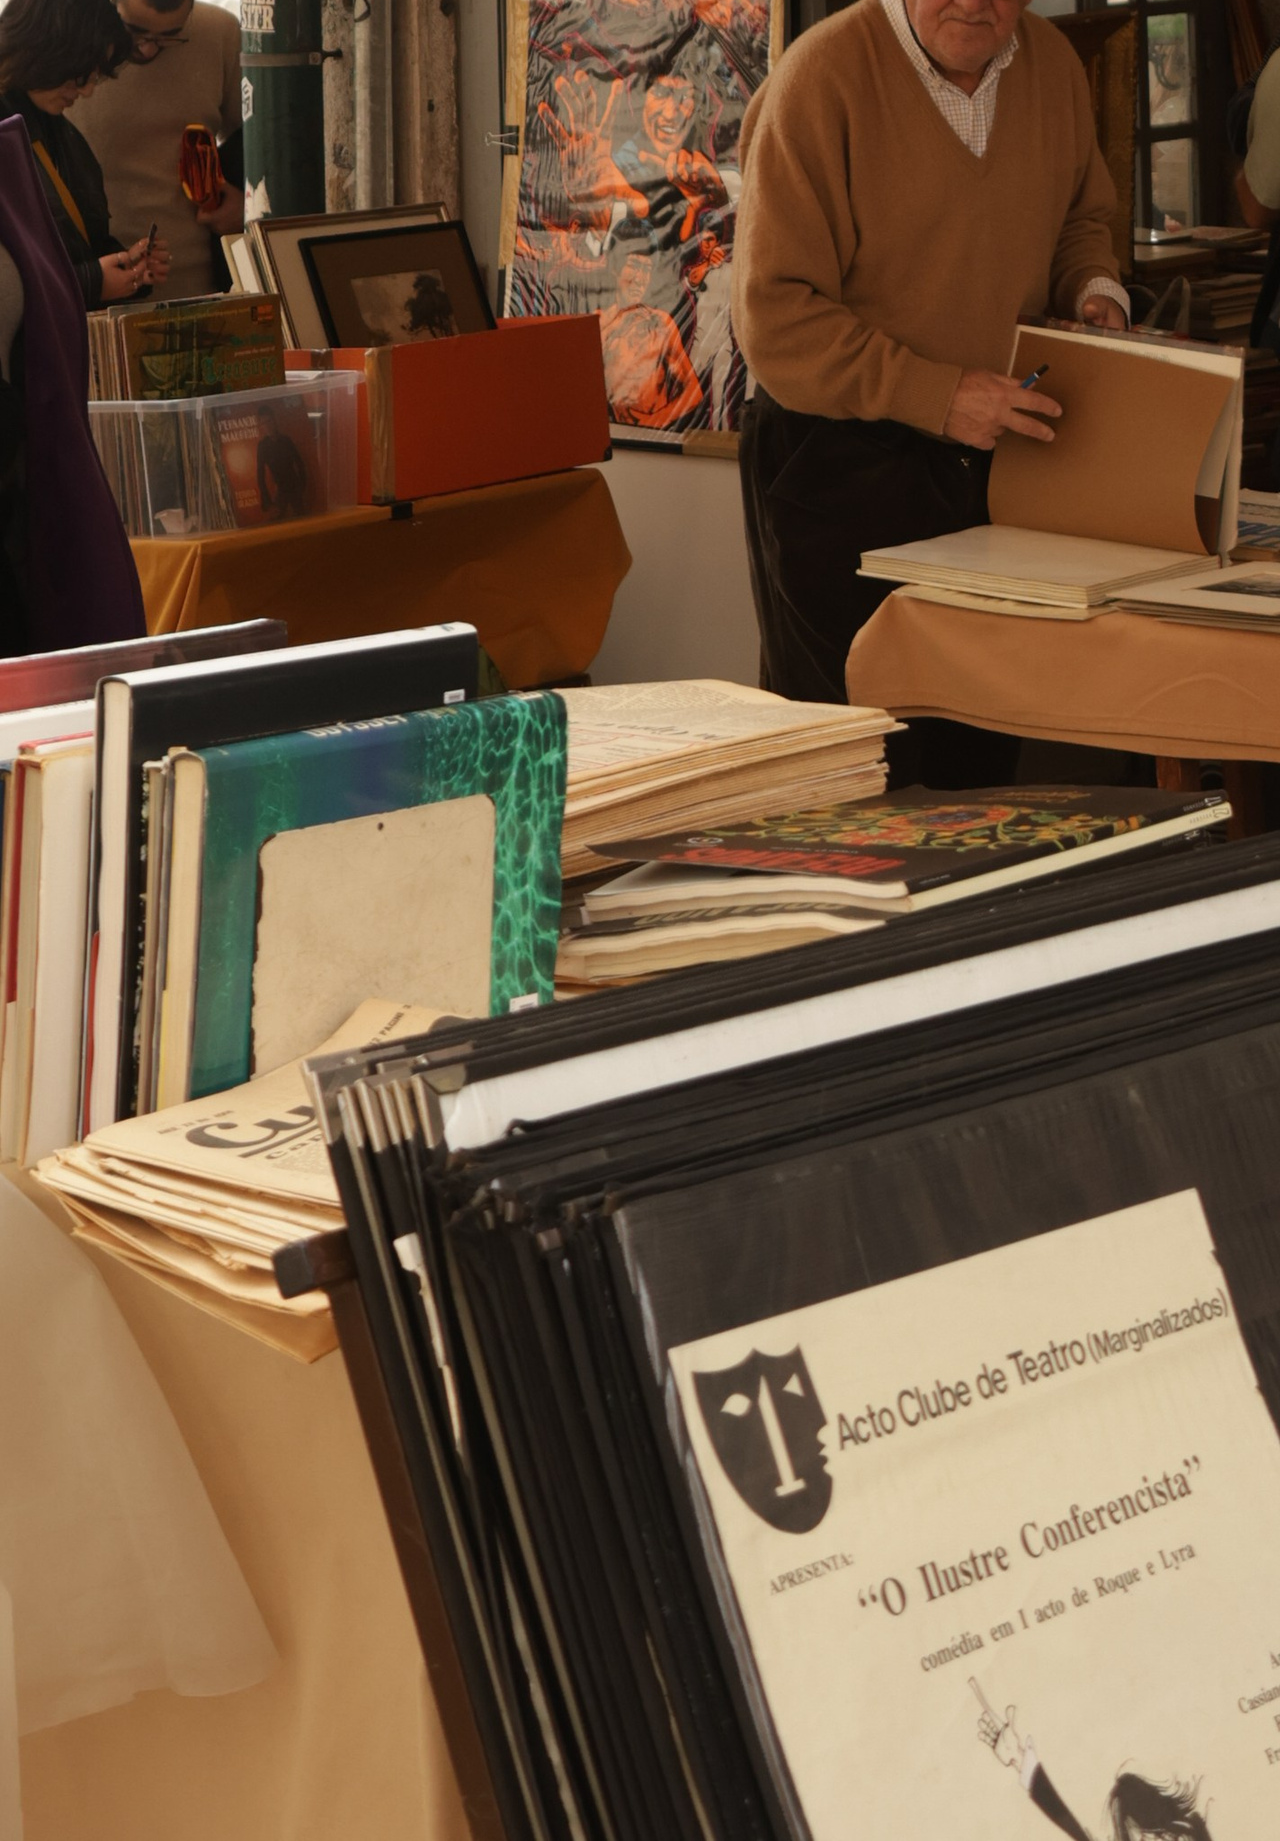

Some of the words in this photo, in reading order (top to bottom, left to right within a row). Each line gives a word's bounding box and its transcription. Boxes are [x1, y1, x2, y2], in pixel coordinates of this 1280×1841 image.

[185, 1105, 317, 1149] Cu
[837, 1403, 898, 1451] Acto
[896, 1380, 972, 1427] Clube
[975, 1363, 1008, 1400] de
[1006, 1338, 1086, 1387] Teatro
[1086, 1287, 1229, 1364] (Marginalizados)
[768, 1552, 855, 1597] APRESENTA:
[916, 1546, 1010, 1603] Ilustre
[919, 1633, 985, 1673] comédia
[989, 1620, 1015, 1643] em
[1034, 1598, 1066, 1625] acto
[1071, 1586, 1090, 1609] de
[1092, 1566, 1142, 1600] Roque
[1145, 1562, 1156, 1577] e
[1158, 1542, 1197, 1573] Lyra
